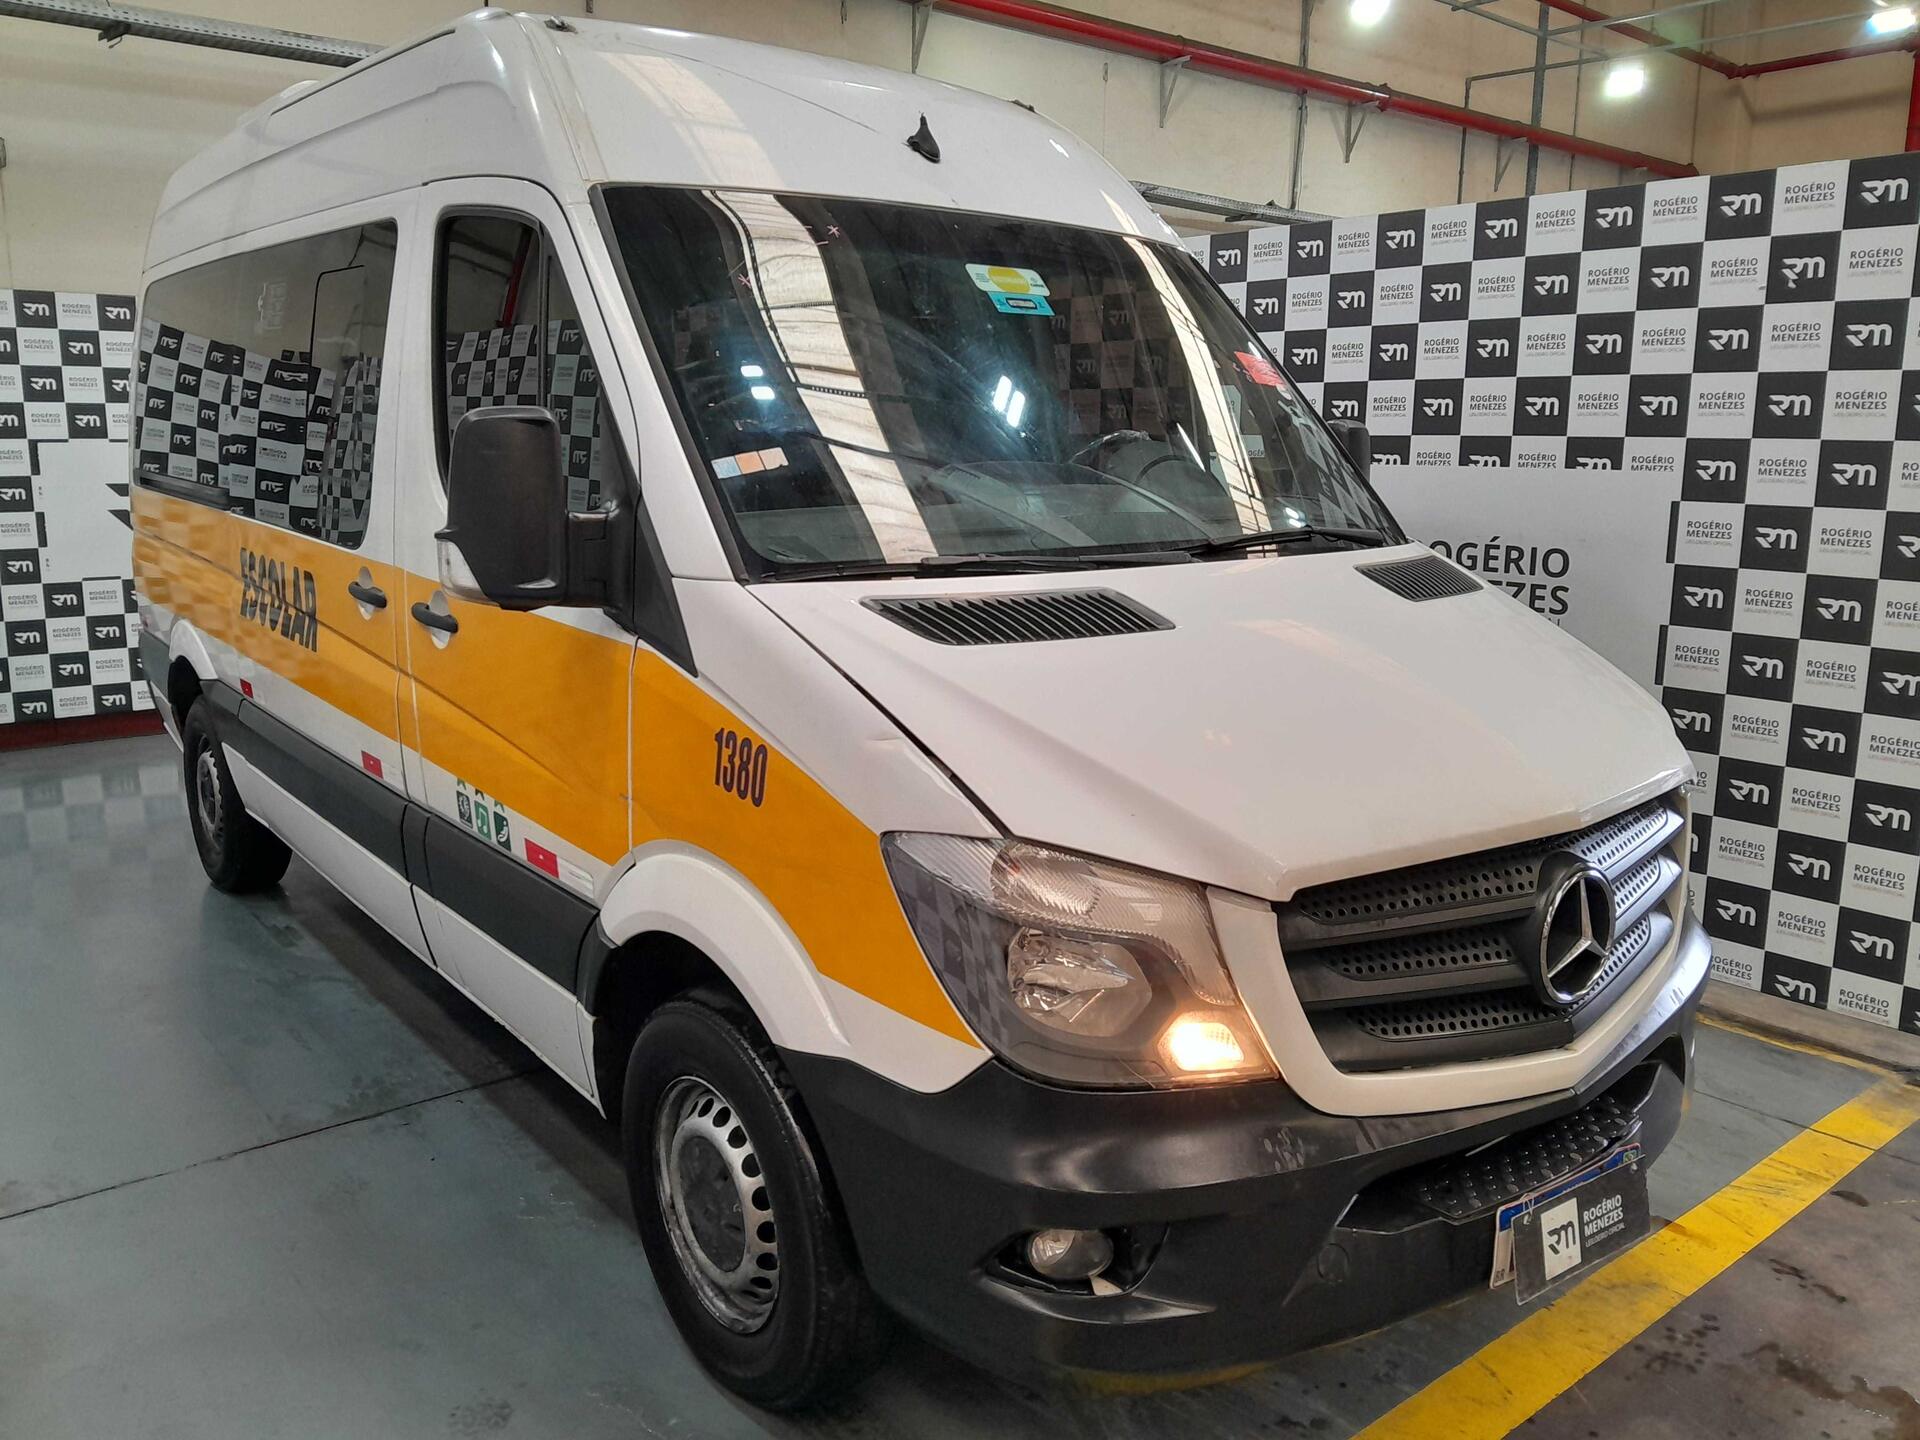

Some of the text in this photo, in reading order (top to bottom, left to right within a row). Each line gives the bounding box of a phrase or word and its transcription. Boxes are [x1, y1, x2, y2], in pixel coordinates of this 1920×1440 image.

[1784, 191, 1836, 204] MENEZES
[1652, 205, 1697, 217] MENEZES
[1535, 218, 1575, 229] MENEZES
[1431, 229, 1467, 239] MENEZES
[1337, 239, 1369, 248] MENEZES
[1253, 247, 1282, 256] MENEZES
[1849, 257, 1904, 269] MENEZES
[1710, 267, 1758, 278] MENEZES
[1587, 276, 1629, 286] MENEZES
[1478, 284, 1515, 294] MENEZES
[1380, 291, 1413, 300] MENEZES
[1292, 298, 1322, 306] MENEZES
[1641, 337, 1685, 347] MENEZES
[1771, 332, 1821, 342] MENEZES
[1424, 346, 1459, 354] MENEZES
[1526, 342, 1566, 350] MENEZES
[1834, 401, 1887, 409] MENEZES
[1757, 468, 1806, 477] MENEZES
[1686, 529, 1731, 539] MENEZES
[1819, 537, 1871, 547] MENEZES
[240, 547, 317, 652] ESCOLAR
[1744, 597, 1792, 609] MENEZES
[1674, 653, 1719, 665] MENEZES
[1805, 668, 1855, 681] MENEZES
[1731, 723, 1778, 737] MENEZES
[714, 728, 768, 808] 1380
[1791, 795, 1840, 811] MENEZES
[1719, 844, 1765, 861] MENEZES
[1853, 872, 1906, 890] MENEZES
[1778, 919, 1826, 937] MENEZES
[1839, 997, 1890, 1017] MENEZES
[1584, 1194, 1622, 1224] ROGÉRIO
[1584, 1207, 1624, 1237] MENEZES
